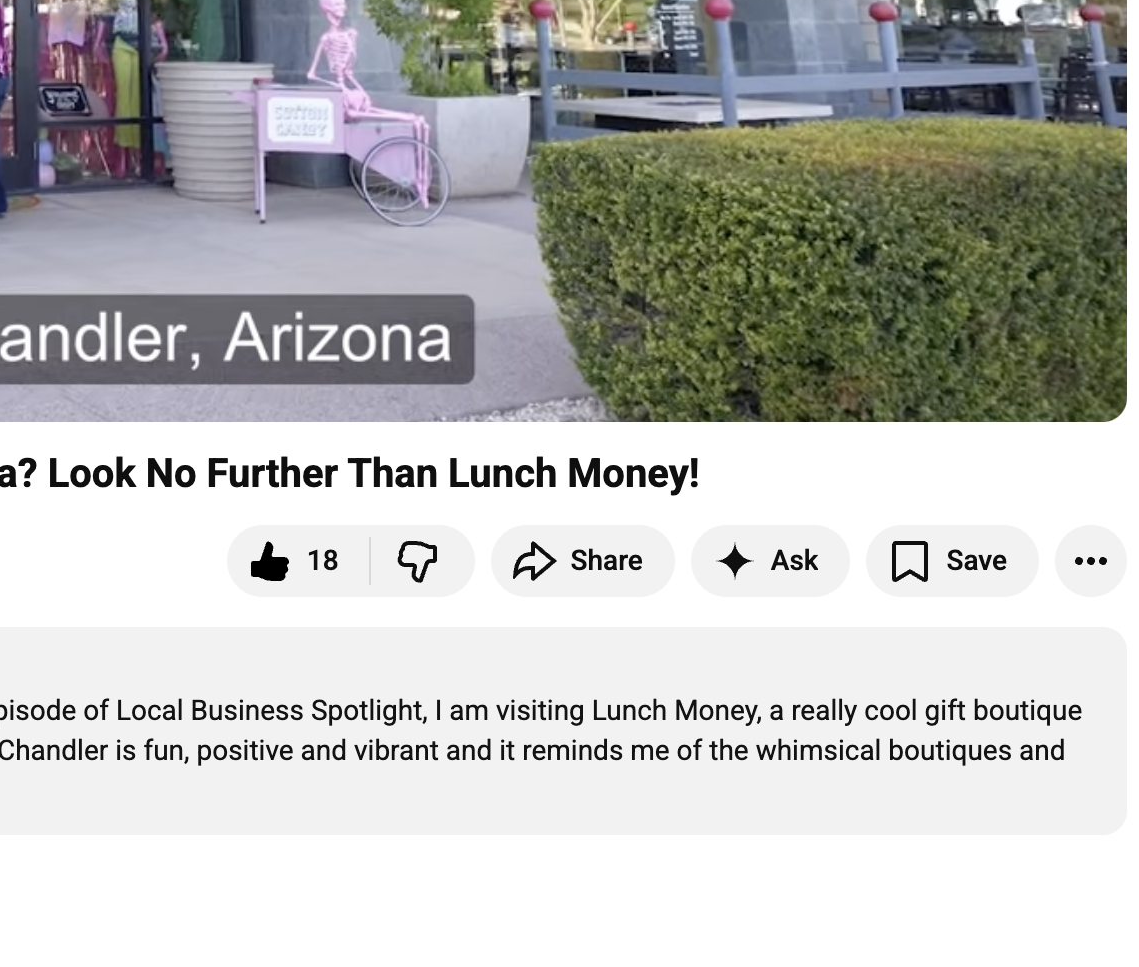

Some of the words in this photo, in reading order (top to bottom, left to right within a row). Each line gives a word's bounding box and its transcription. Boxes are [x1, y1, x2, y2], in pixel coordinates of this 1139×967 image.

[49, 455, 138, 489] Look
[147, 457, 197, 489] No
[208, 455, 339, 489] Further
[347, 455, 438, 489] Than
[449, 455, 557, 489] Lunch
[568, 457, 699, 497] Money!
[308, 548, 339, 571] 18
[570, 547, 643, 572] Share
[770, 547, 819, 571] Ask
[946, 548, 1008, 572] Save
[83, 697, 110, 721] of
[117, 697, 183, 721] Local
[191, 698, 304, 721] Business
[311, 697, 428, 727] Spotlight,
[436, 698, 441, 721] I
[449, 703, 489, 721] am
[495, 698, 584, 727] visiting
[593, 697, 667, 721] Lunch
[675, 698, 762, 727] Money,
[769, 703, 784, 721] a
[792, 697, 858, 727] really
[864, 697, 917, 721] cool
[924, 697, 966, 727] gift
[973, 697, 1083, 727] boutique
[116, 738, 136, 761] is
[143, 737, 190, 765] fun,
[197, 738, 294, 767] positive
[301, 737, 346, 761] and
[353, 737, 439, 762] vibrant
[446, 737, 492, 761] and
[500, 738, 516, 762] it
[523, 737, 623, 761] reminds
[631, 743, 670, 761] me
[676, 737, 704, 761] of
[708, 737, 749, 762] the
[755, 737, 881, 761] whimsical
[889, 737, 1012, 767] boutiques
[1019, 737, 1065, 761] and
